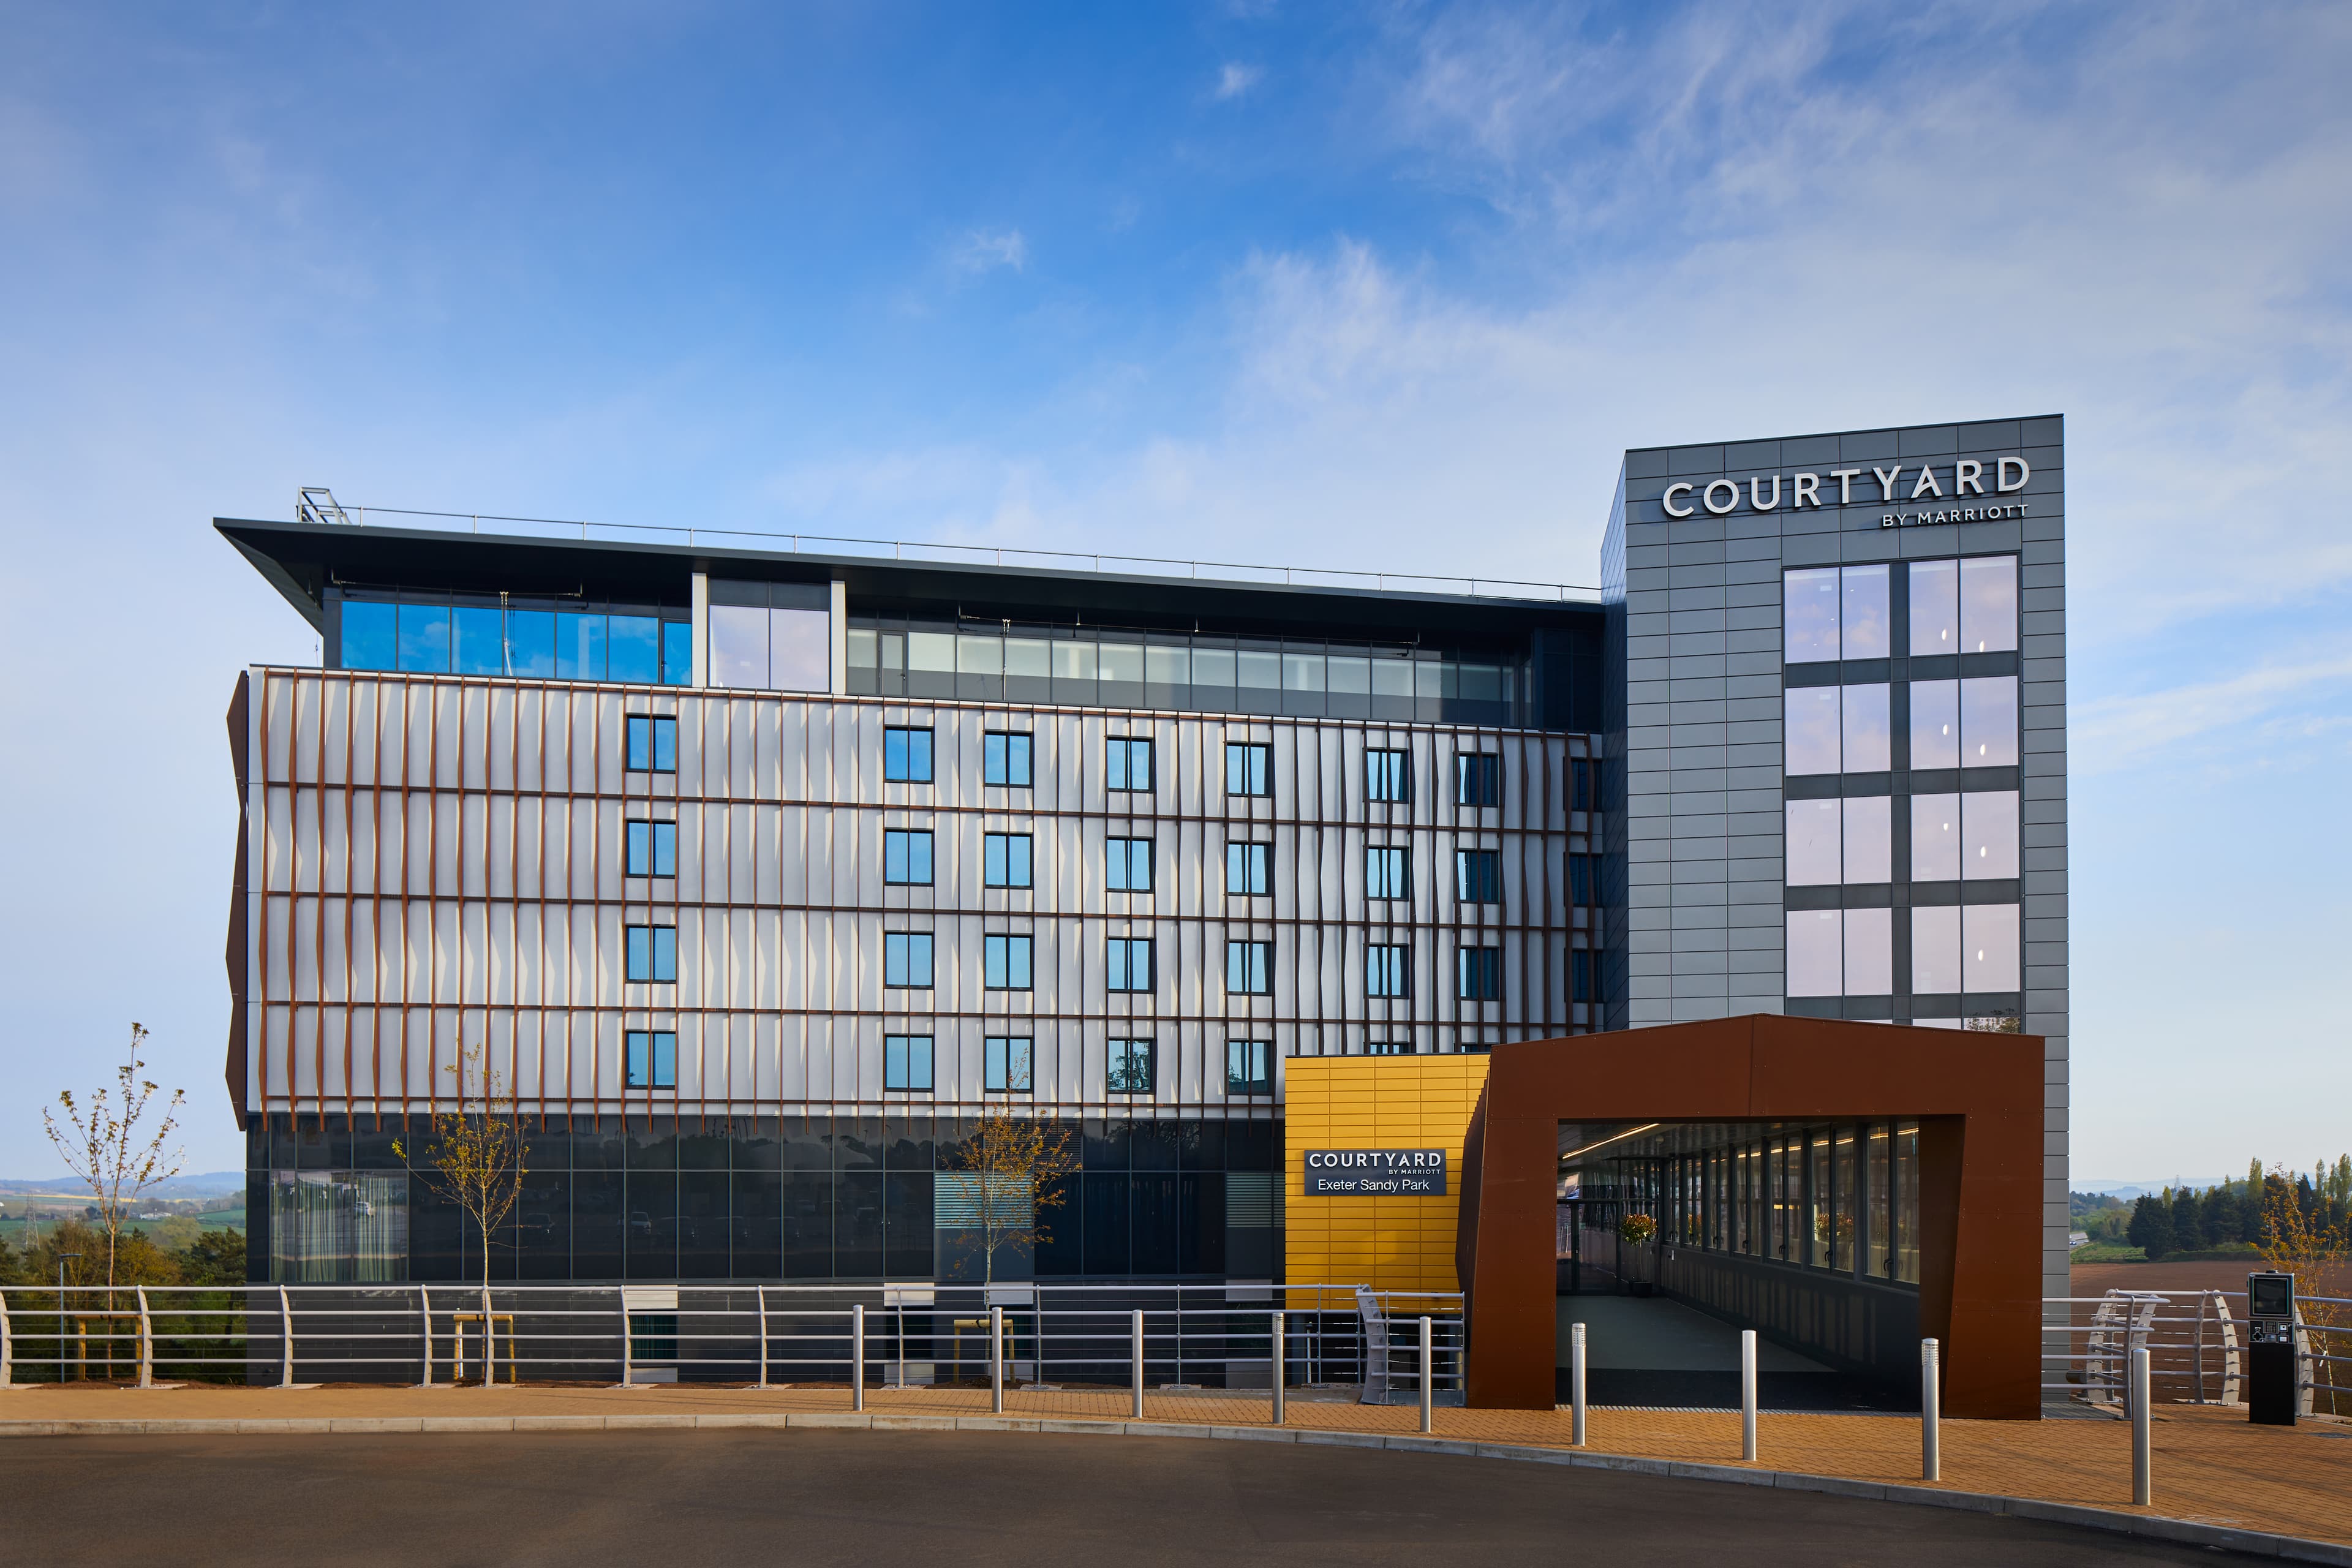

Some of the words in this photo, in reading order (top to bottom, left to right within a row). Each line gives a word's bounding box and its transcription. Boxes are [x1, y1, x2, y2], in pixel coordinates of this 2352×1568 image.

[1662, 456, 2030, 518] COURTYARD
[1882, 513, 1907, 527] BY
[1917, 503, 2029, 525] MARRIOTT
[1309, 1153, 1441, 1167] COURTYARD
[1318, 1179, 1357, 1190] Exeter
[1360, 1179, 1398, 1193] Sandy
[1402, 1179, 1430, 1190] Park
